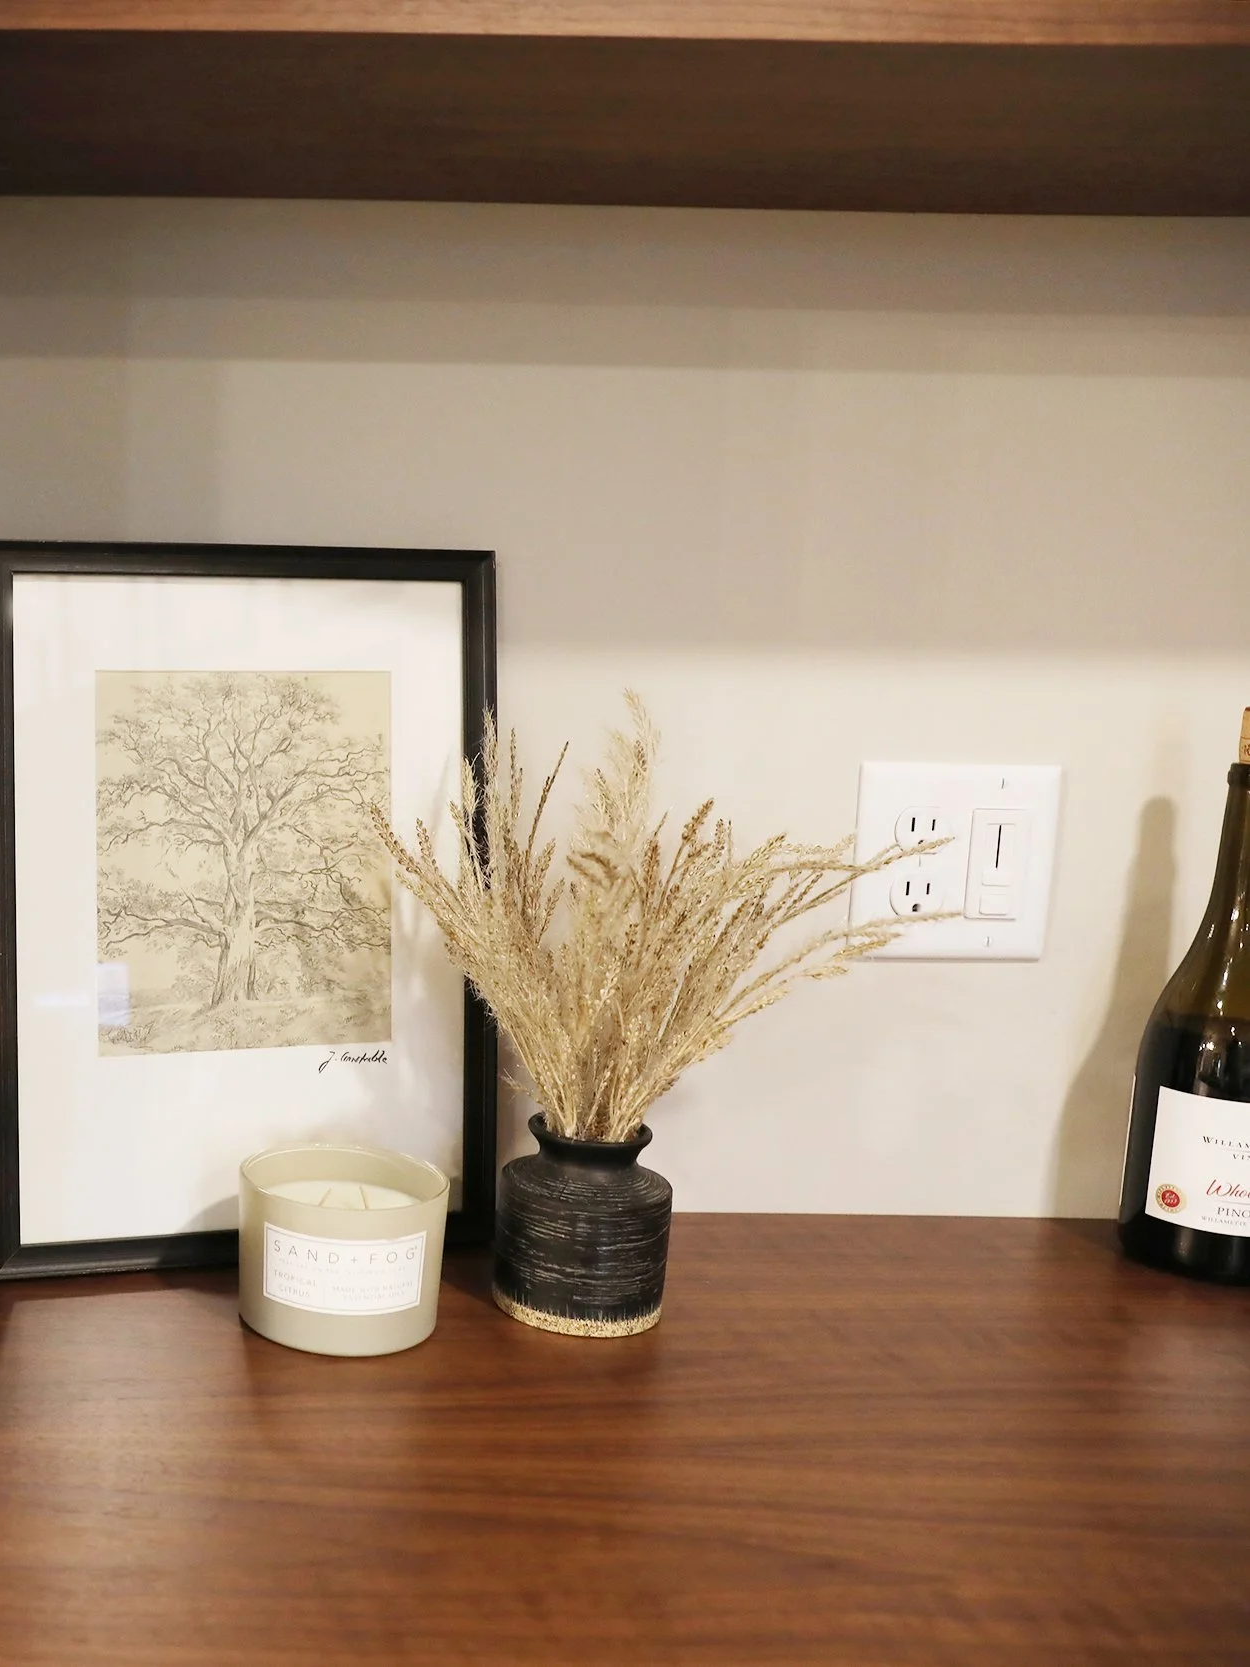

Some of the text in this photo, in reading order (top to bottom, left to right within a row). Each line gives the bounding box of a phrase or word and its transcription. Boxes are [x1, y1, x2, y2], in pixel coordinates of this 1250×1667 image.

[273, 1239, 340, 1265] SAND
[273, 1268, 318, 1288] TROPICAL
[278, 1283, 311, 1298] CITRUS
